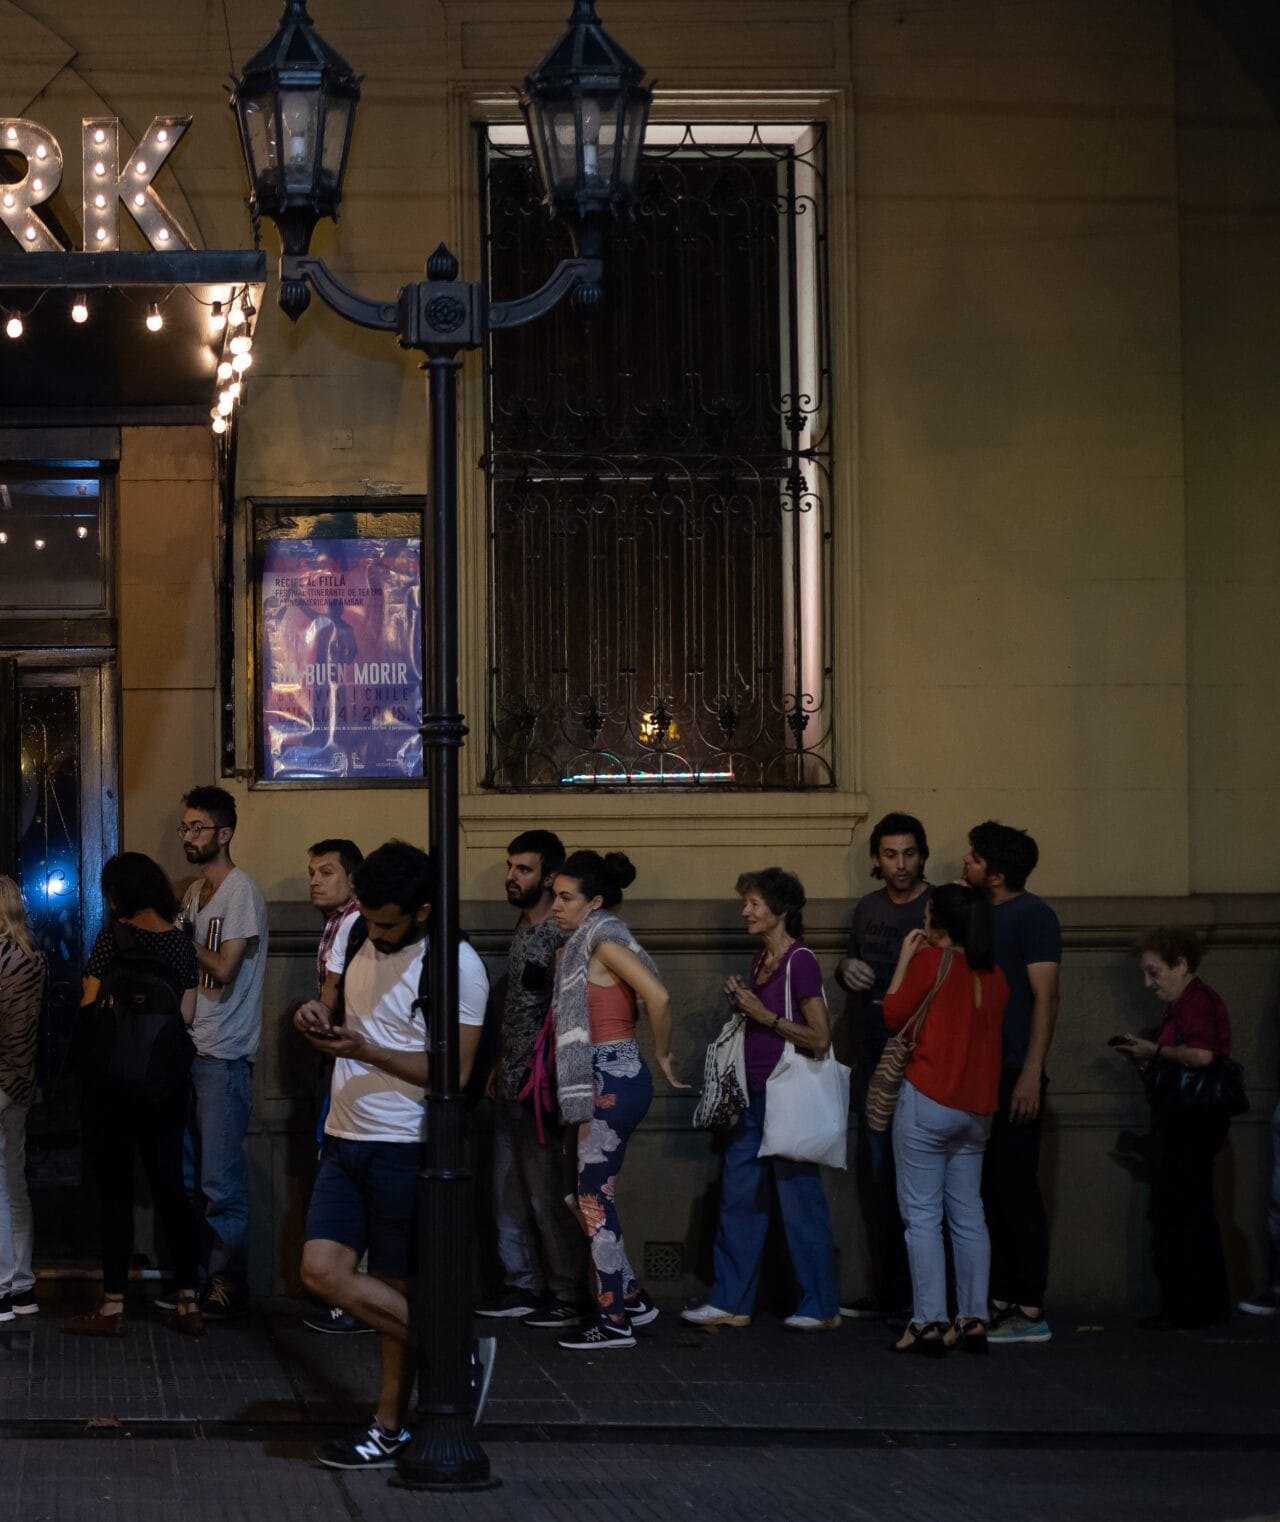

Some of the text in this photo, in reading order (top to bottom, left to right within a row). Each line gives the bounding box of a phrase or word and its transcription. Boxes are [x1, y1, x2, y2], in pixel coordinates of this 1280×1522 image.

[305, 662, 348, 684] BUEN
[353, 662, 408, 684] MORIR
[365, 687, 409, 701] CHILE
